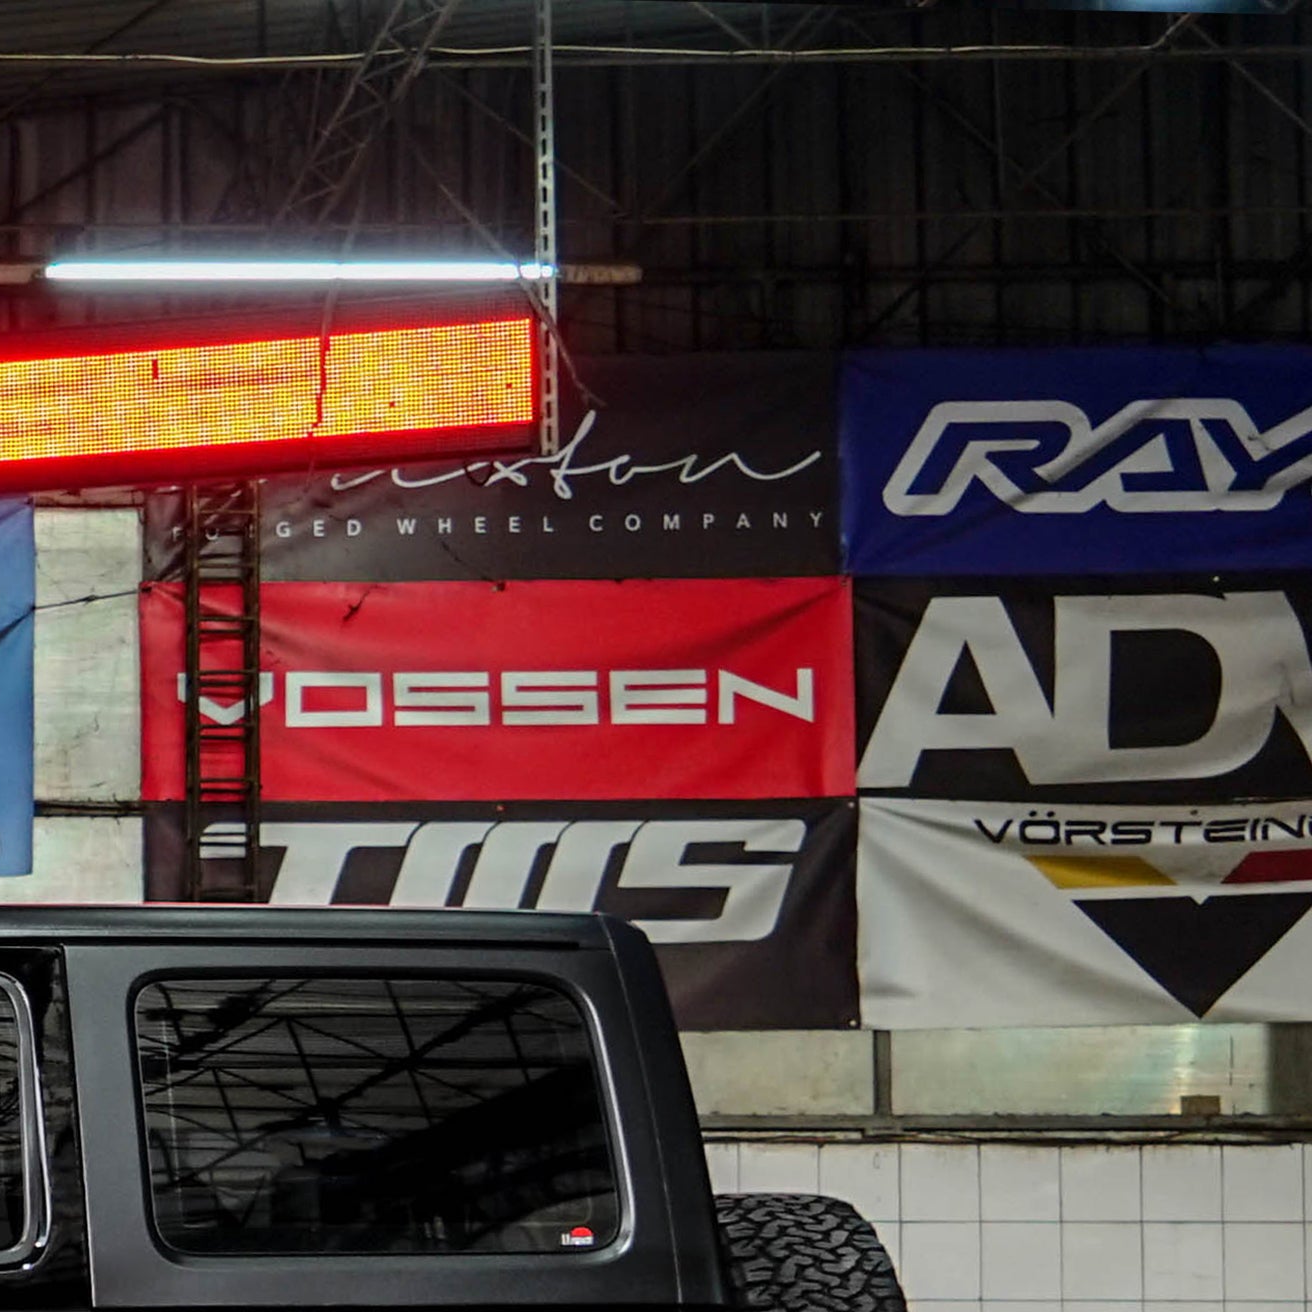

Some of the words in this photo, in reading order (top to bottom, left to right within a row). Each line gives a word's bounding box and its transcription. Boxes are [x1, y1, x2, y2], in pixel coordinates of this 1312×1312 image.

[397, 515, 554, 537] WHEEL
[589, 511, 824, 533] COMPANY
[177, 668, 815, 728] VOSSEN
[973, 810, 1312, 846] VÖRSTEIN
